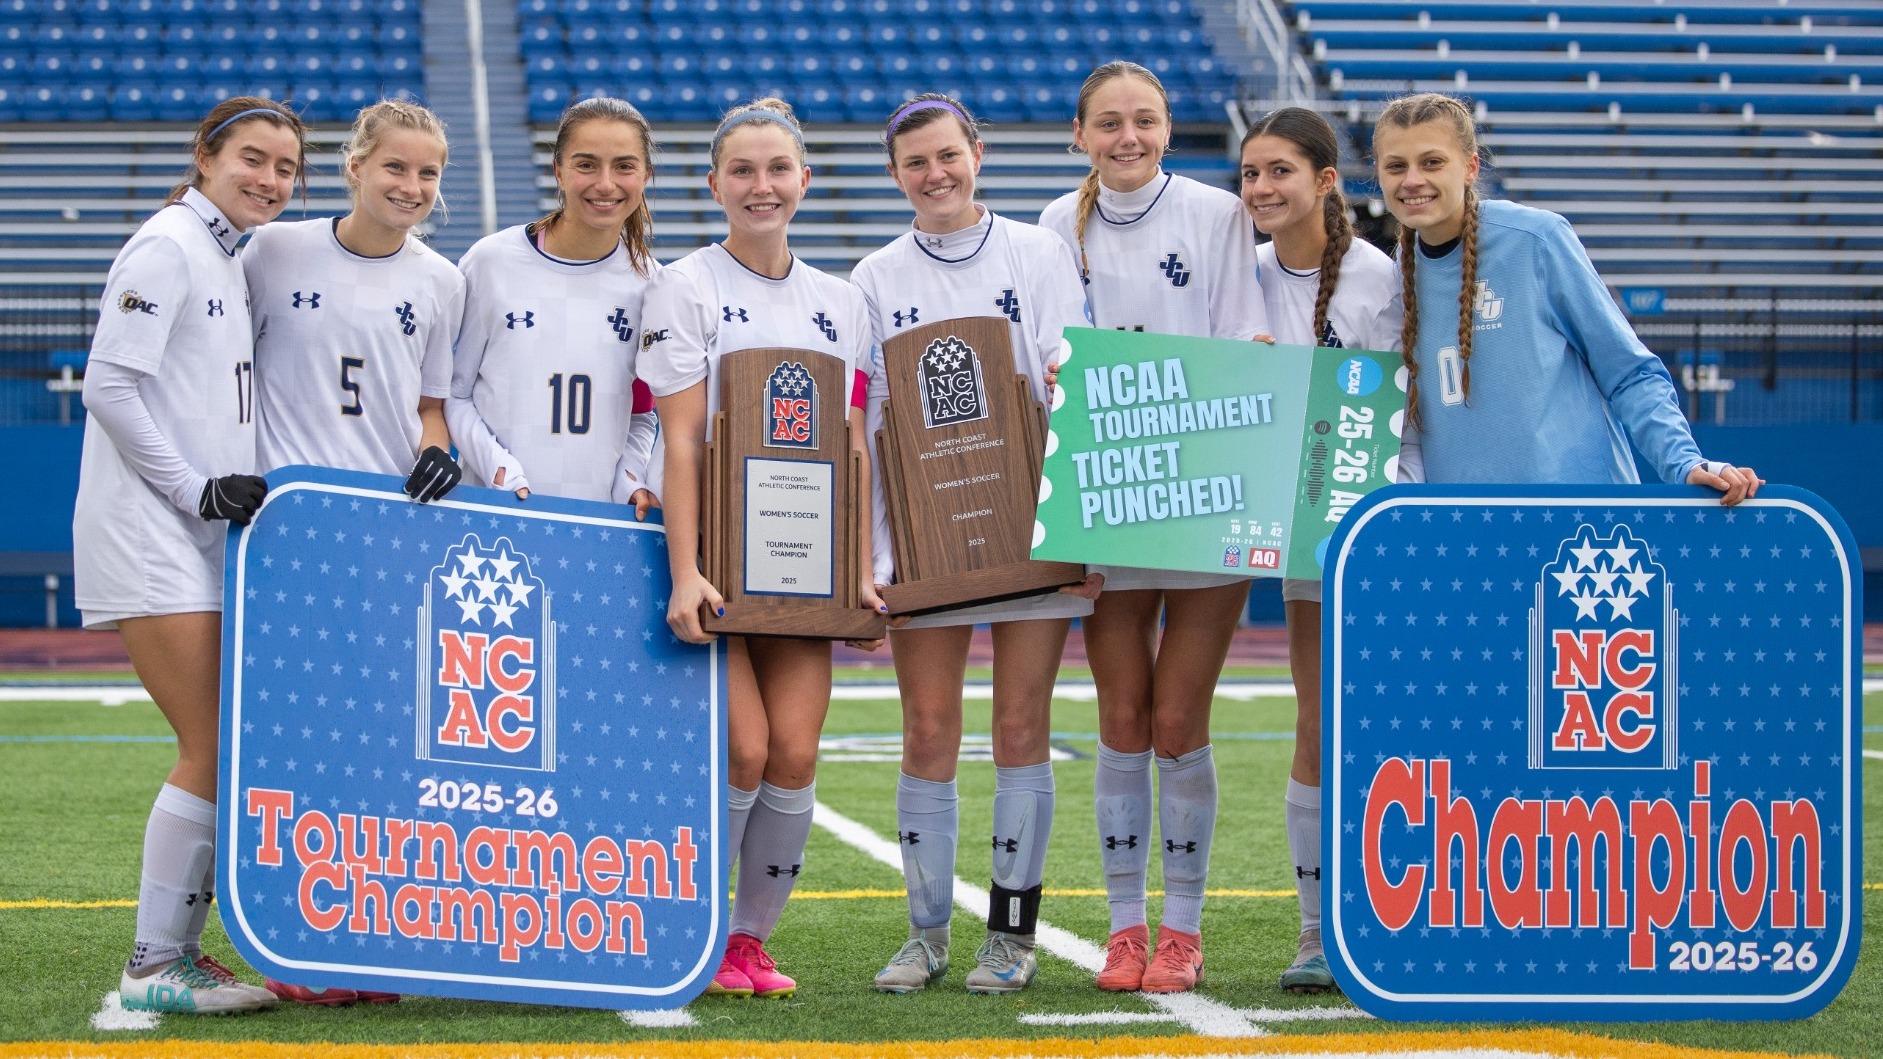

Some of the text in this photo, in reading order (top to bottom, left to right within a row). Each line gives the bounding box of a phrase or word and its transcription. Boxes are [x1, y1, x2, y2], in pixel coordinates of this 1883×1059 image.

[1158, 252, 1192, 289] JCU
[124, 297, 159, 315] OAC
[395, 301, 416, 336] JCU
[606, 306, 635, 344] JCU
[643, 328, 669, 347] OAC
[812, 310, 838, 343] JCU
[1472, 323, 1503, 331] OCCER
[235, 361, 251, 424] 17
[341, 355, 365, 417] 5
[929, 370, 973, 398] NC
[1084, 358, 1189, 410] NCAA
[1347, 359, 1362, 395] NCAA
[548, 372, 592, 435] 10
[773, 397, 810, 421] NC
[934, 392, 976, 419] AC
[1089, 392, 1273, 443] TOURNAMENT
[773, 419, 810, 442] AC
[934, 433, 987, 449] NORTH COAST
[1332, 405, 1375, 483] 25-26
[920, 439, 1004, 460] ATHLETIC CONFERENCE
[1071, 441, 1180, 489] TICKET
[759, 482, 821, 491] ATHLETIC CONFERENCE
[934, 473, 1000, 490] WOMEN'S SOCCER
[759, 510, 819, 519] WOMEN'S SOCCER
[952, 508, 993, 521] CHAMPION
[1080, 474, 1245, 529] PUNCHED!
[765, 541, 813, 550] TOURNAMENT
[968, 537, 986, 546] 2025
[1231, 524, 1283, 537] 19 84 42
[770, 550, 808, 558] CHAMPION
[1251, 550, 1276, 567] AQ
[781, 577, 797, 585] 2025
[438, 628, 537, 694] NC
[1552, 627, 1657, 691] NC
[438, 688, 536, 753] AC
[1552, 690, 1656, 754] AC
[418, 778, 559, 818] 2025-26
[247, 787, 698, 901] Tournament
[1361, 756, 1827, 970] Champion
[298, 859, 648, 963] Champion
[1669, 941, 1818, 972] 2025-26
